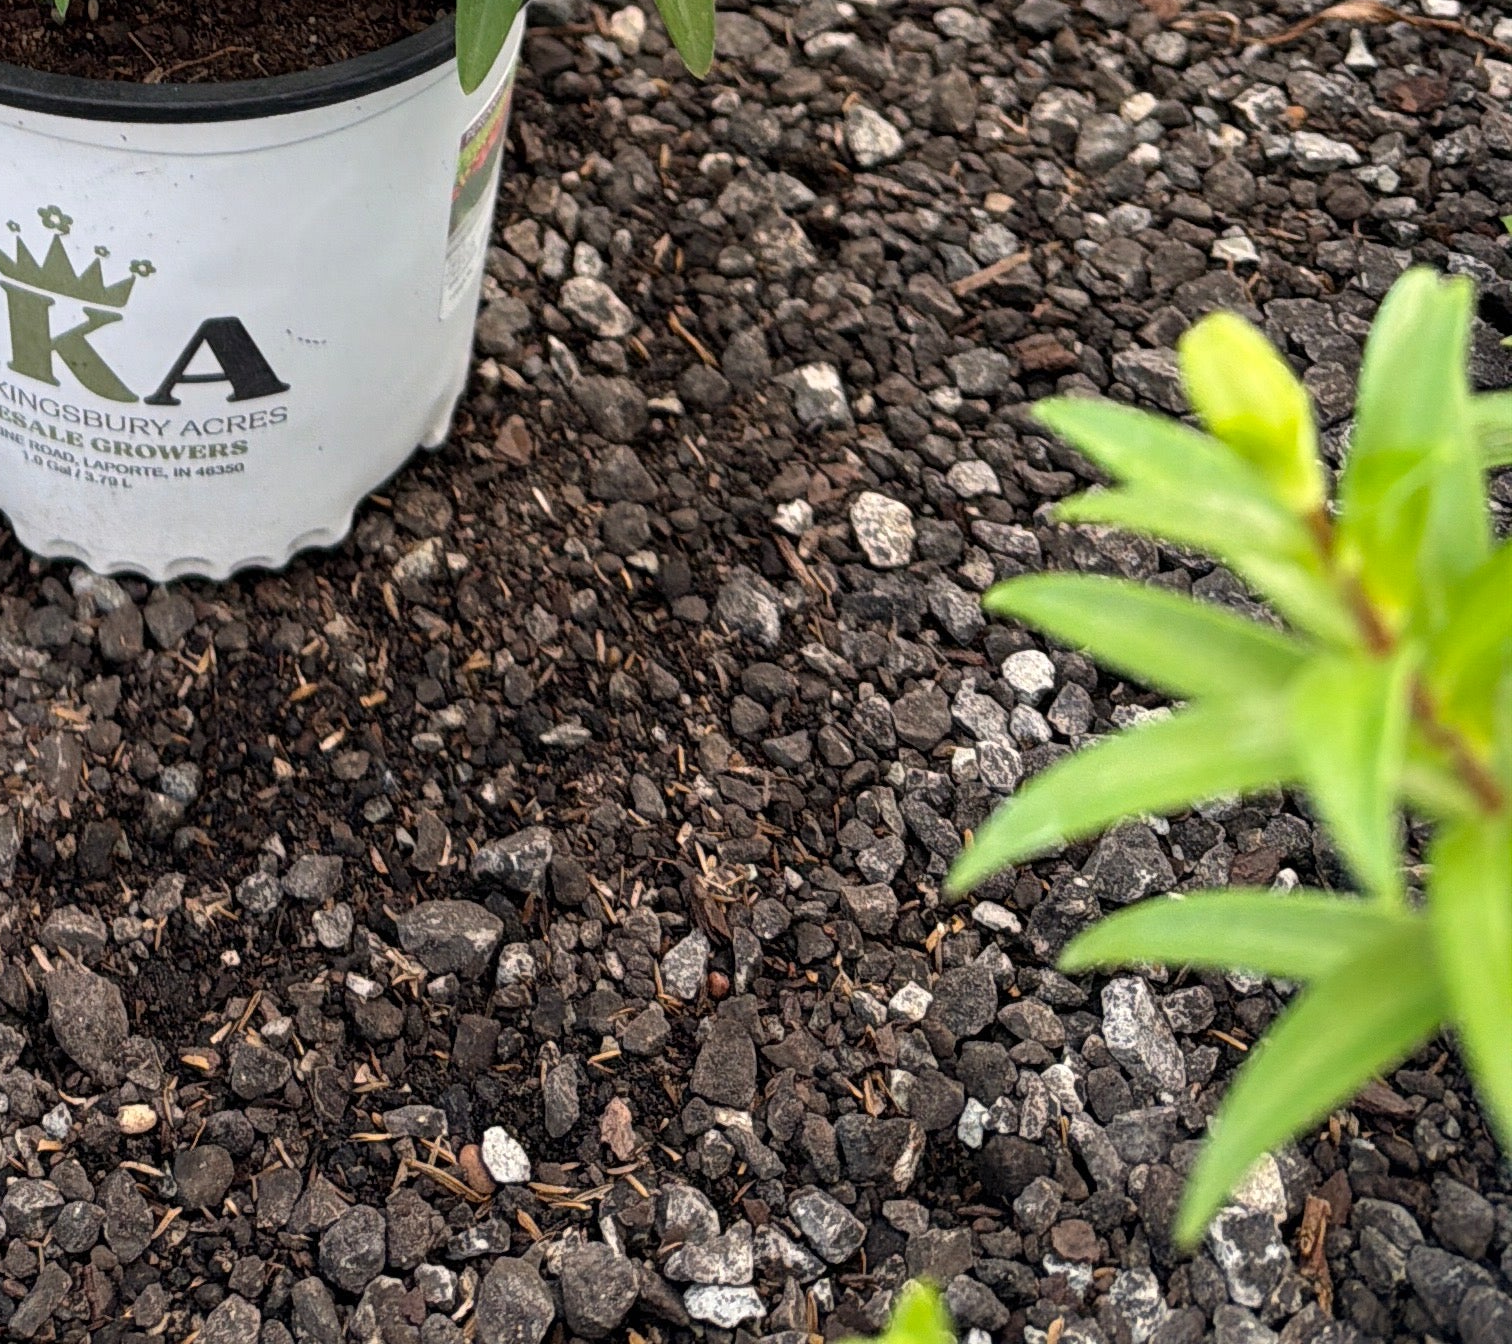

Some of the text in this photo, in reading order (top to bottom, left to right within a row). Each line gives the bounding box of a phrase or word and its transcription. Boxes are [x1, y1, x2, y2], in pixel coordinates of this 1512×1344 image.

[179, 405, 289, 437] ACRES
[28, 439, 79, 467] ROAD,
[84, 456, 170, 480] LAPORTE,
[173, 466, 192, 479] IN
[195, 462, 246, 478] 46350
[91, 436, 249, 461] GROWERS
[46, 459, 73, 478] Gal
